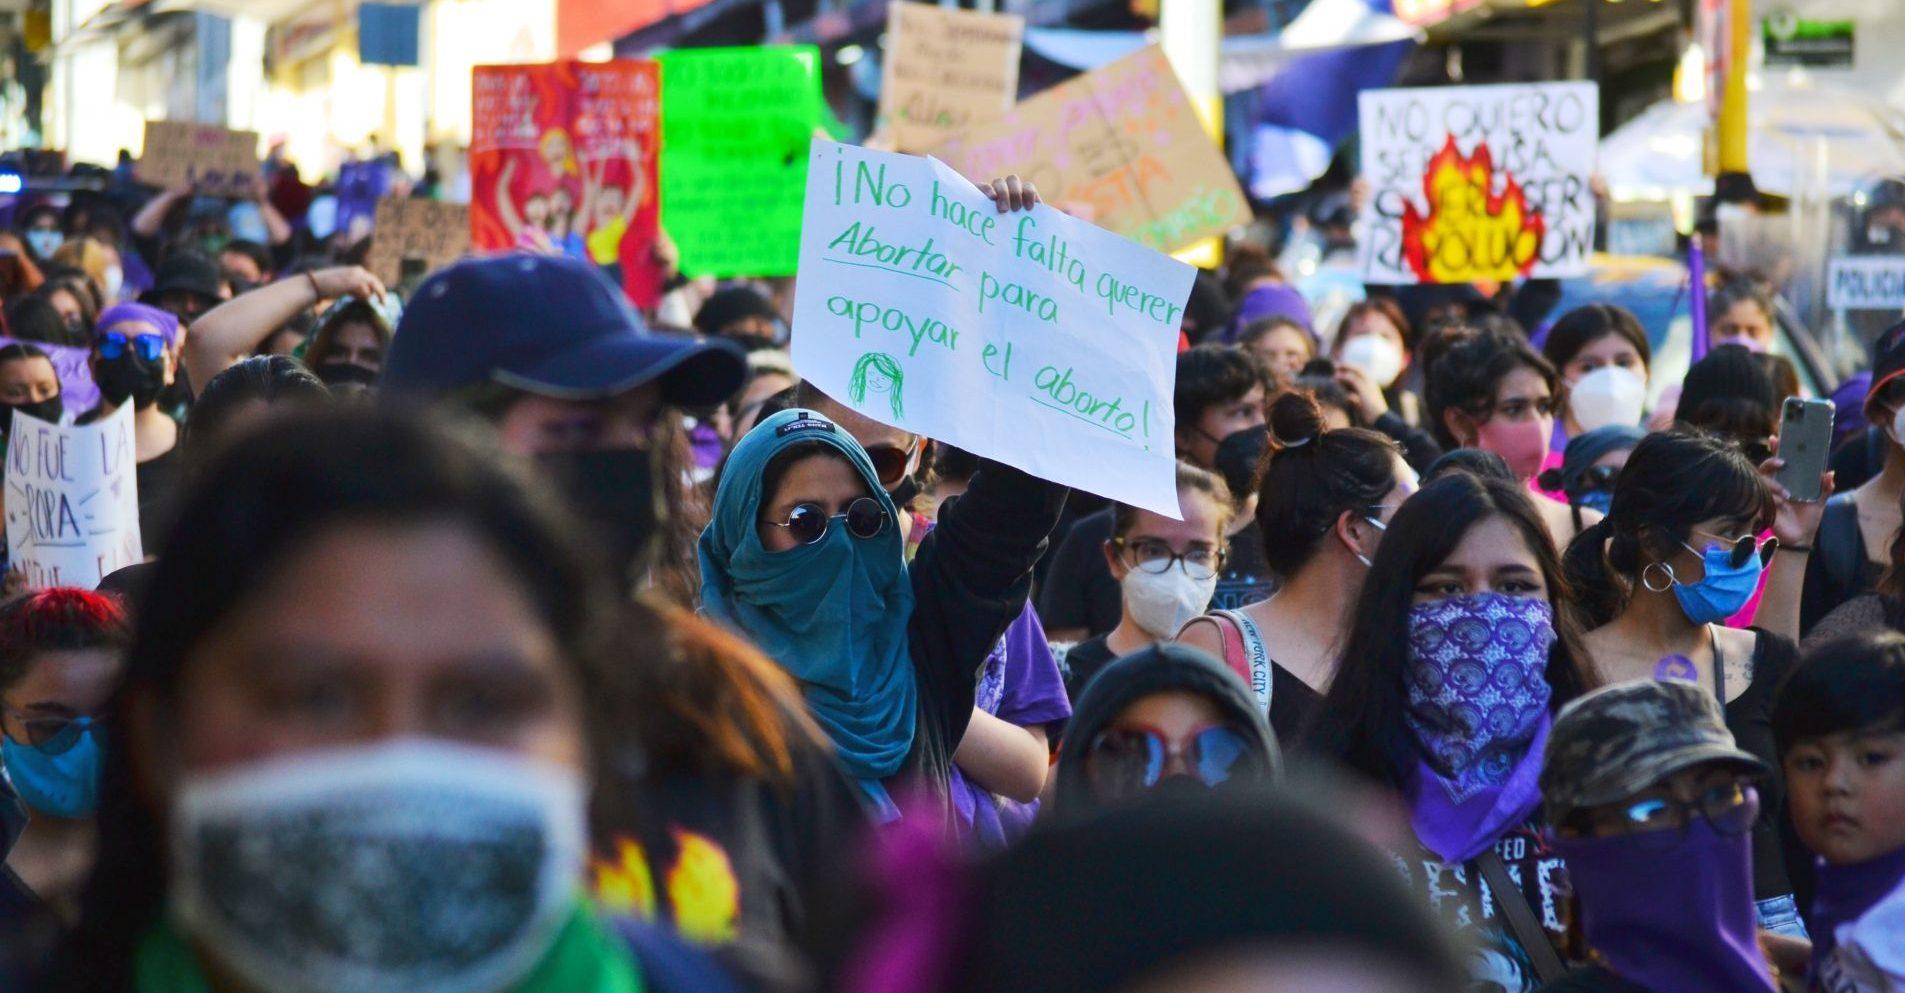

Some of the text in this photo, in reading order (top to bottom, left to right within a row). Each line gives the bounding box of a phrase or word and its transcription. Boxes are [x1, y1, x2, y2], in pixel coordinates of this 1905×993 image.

[1376, 90, 1583, 142] NO QUIERO
[1522, 174, 1582, 218] SER
[827, 221, 1058, 324] Abortar para
[930, 180, 997, 247] hace
[1012, 215, 1086, 294] falta
[1096, 271, 1183, 326] querer
[826, 295, 1151, 452] apoyar el aborto!
[8, 415, 129, 482] NO FUE LA
[1252, 670, 1267, 695] CITY
